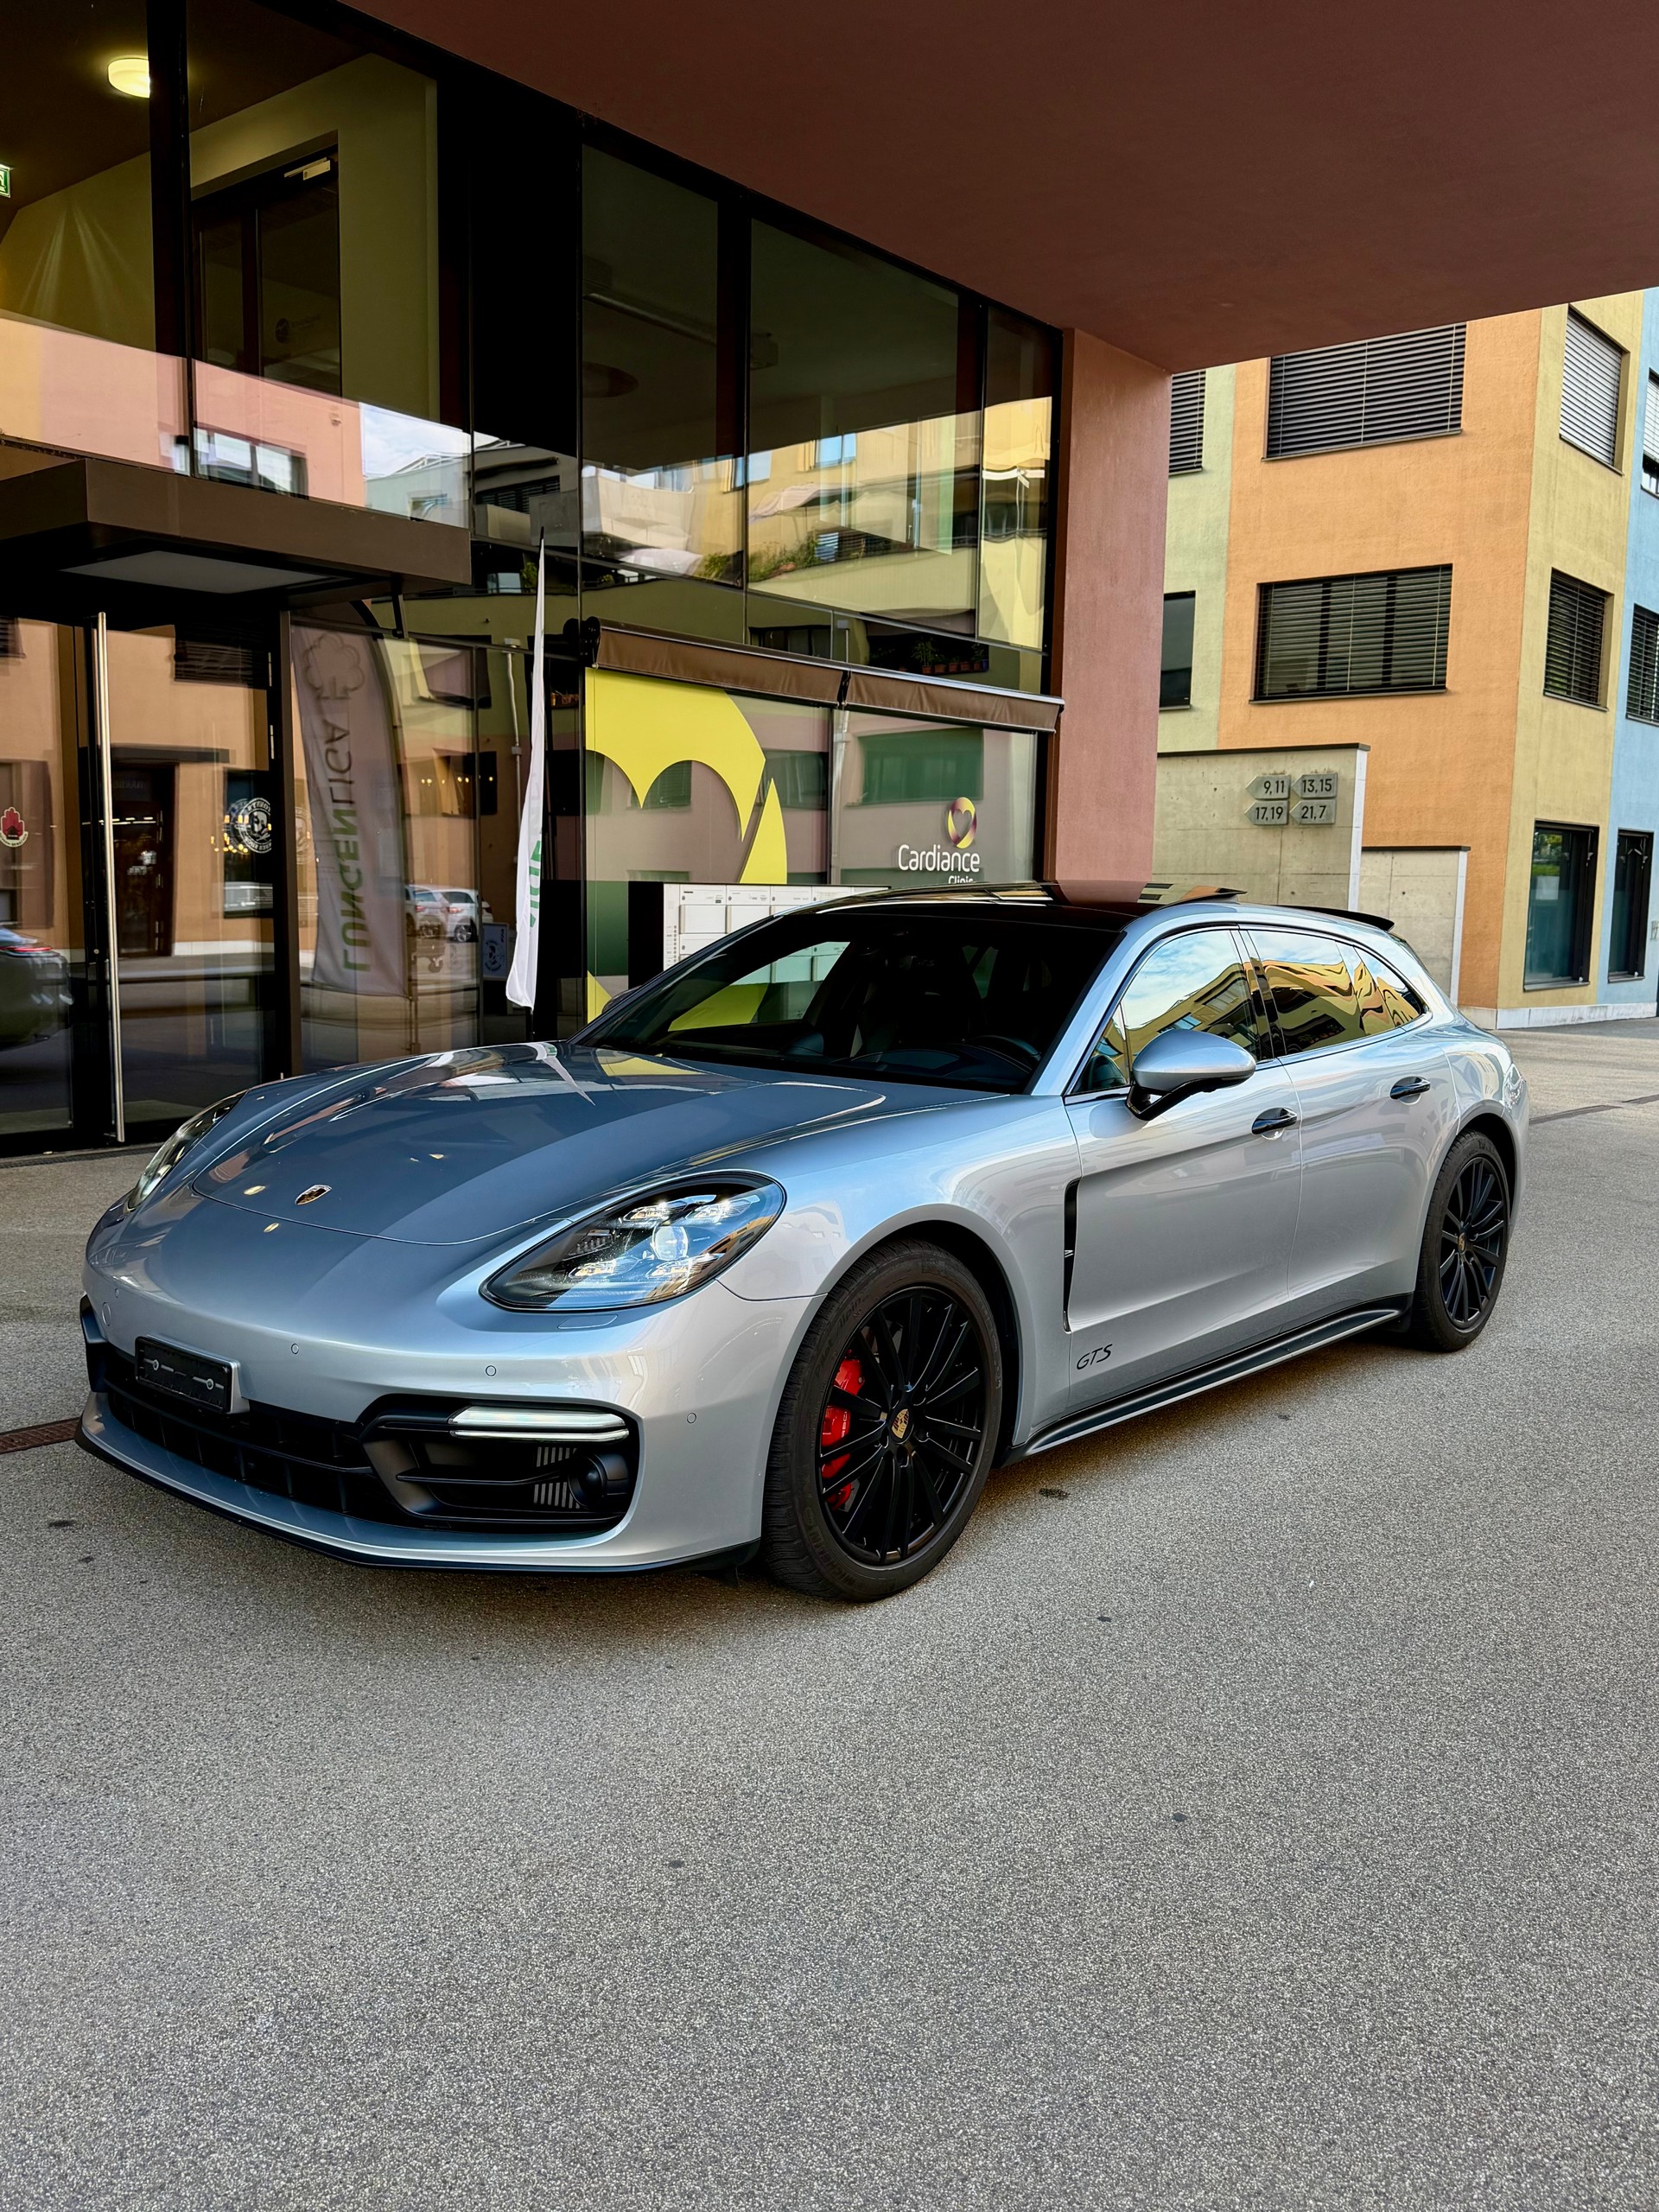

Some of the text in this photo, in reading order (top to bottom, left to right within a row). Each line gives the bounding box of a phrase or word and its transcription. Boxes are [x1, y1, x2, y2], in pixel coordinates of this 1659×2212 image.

[1263, 780, 1285, 795] 9,11
[1302, 779, 1332, 793] 13,15
[1255, 806, 1284, 821] 17,19
[1300, 805, 1327, 820] 21,7
[899, 844, 981, 873] Cardiance
[1077, 1344, 1113, 1370] GTS
